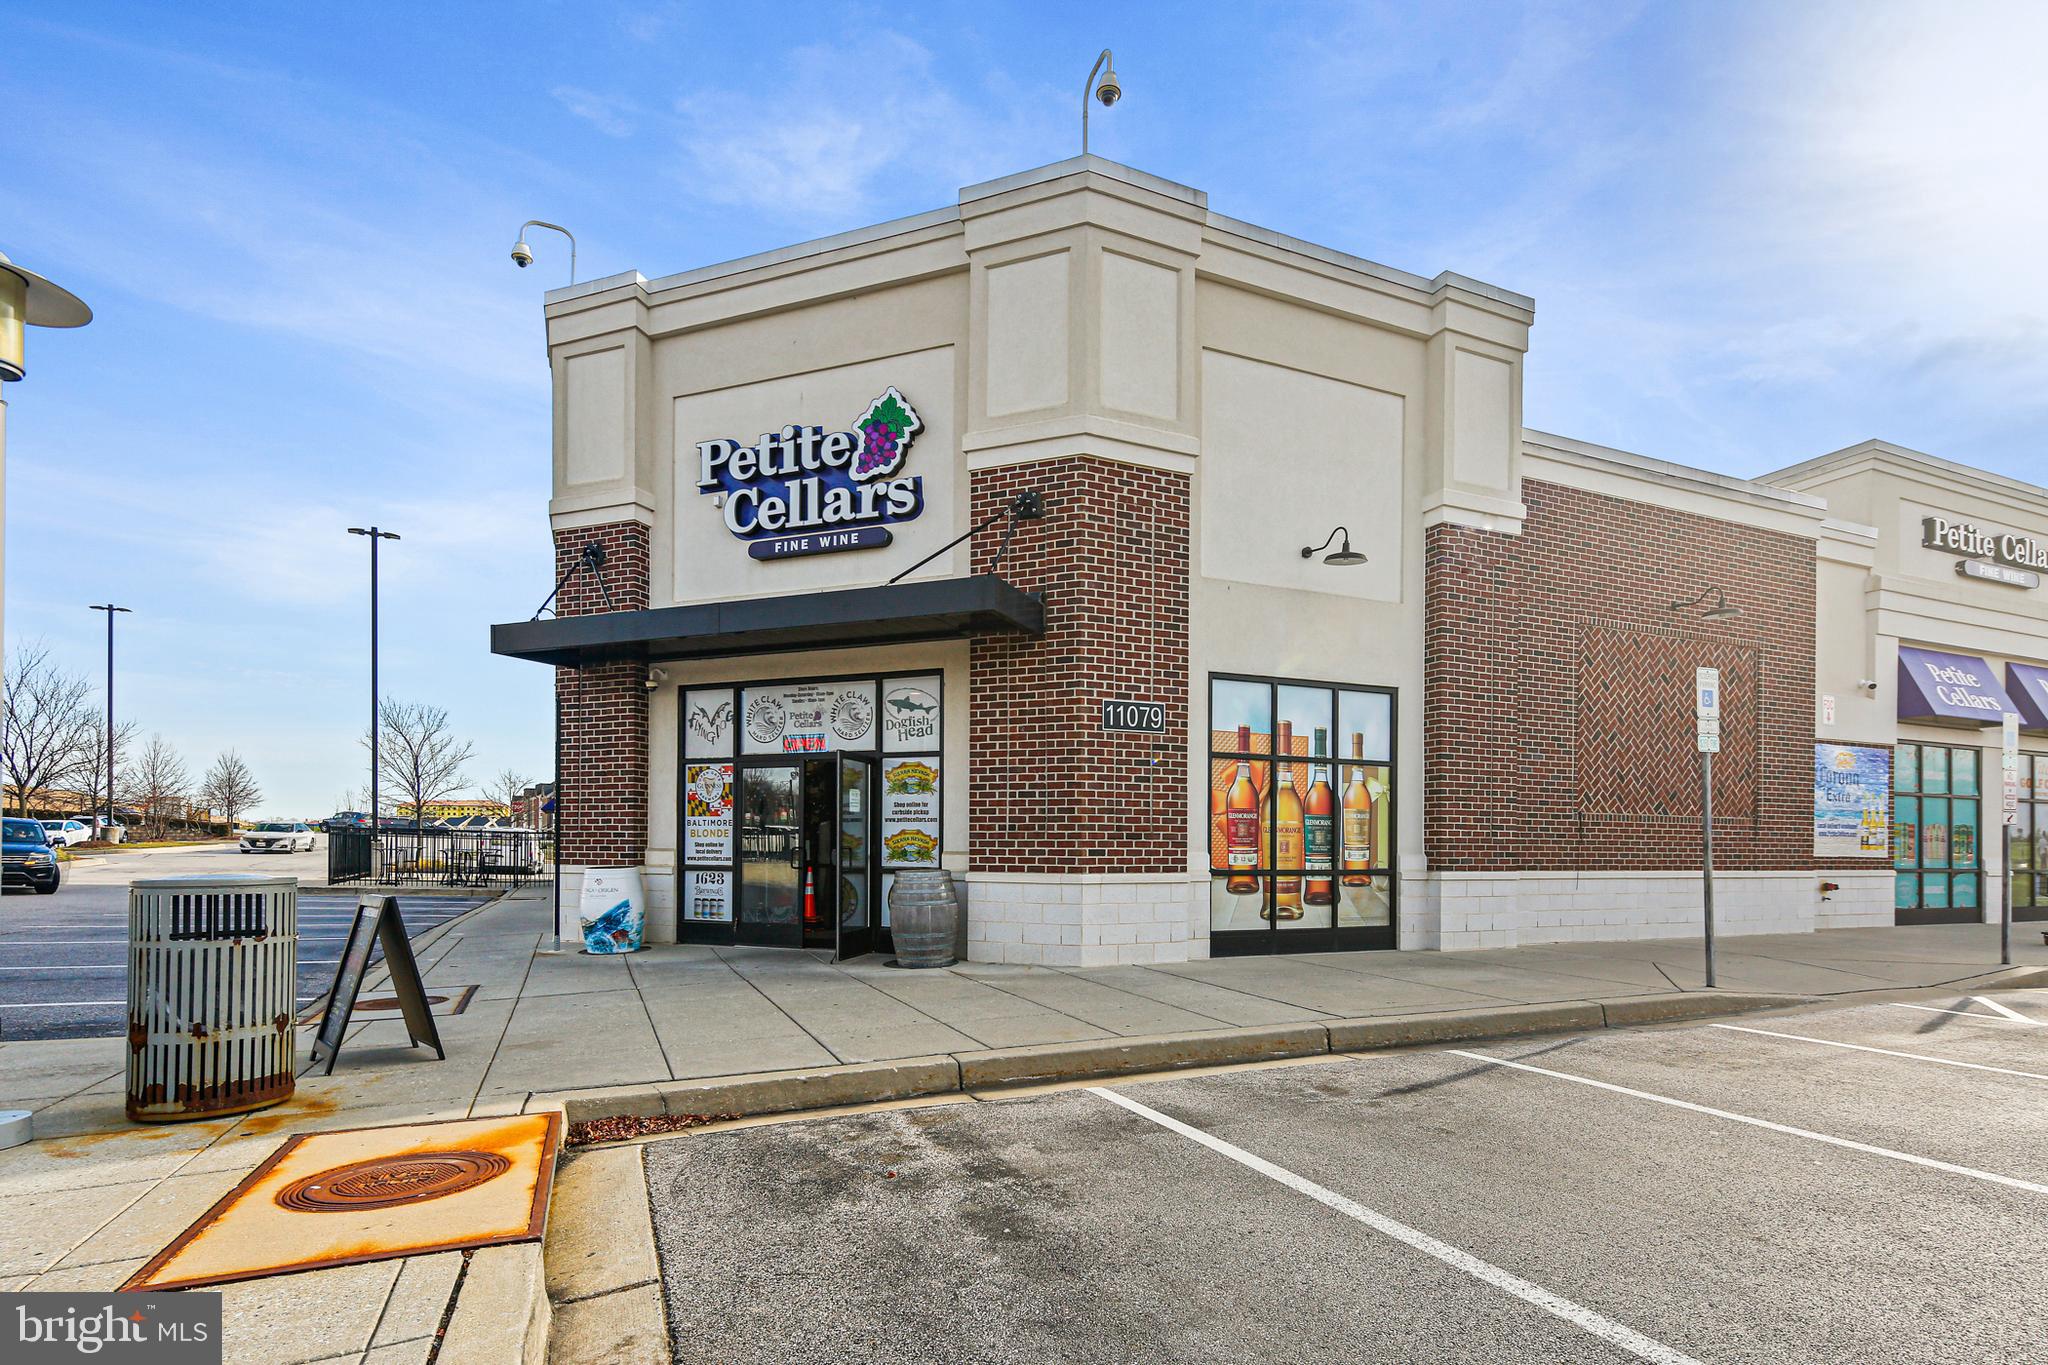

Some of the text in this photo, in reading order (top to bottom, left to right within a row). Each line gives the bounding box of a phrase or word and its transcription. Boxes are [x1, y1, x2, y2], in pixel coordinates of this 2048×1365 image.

[696, 425, 853, 487] Petite
[723, 476, 916, 534] Cellars
[775, 533, 859, 553] FINE WINE
[1933, 517, 2048, 568] Petite Cella
[1980, 565, 2025, 583] FINE WINE
[1925, 663, 1981, 688] Petite
[830, 691, 870, 723] WHITE CLAW
[1937, 686, 2002, 711] Cellars
[746, 695, 783, 727] WHITE CLAW
[790, 711, 814, 720] Petite
[1106, 704, 1162, 728] 11079
[794, 720, 823, 728] Cellars
[886, 716, 929, 730] Dogfish
[898, 723, 933, 741] Head
[783, 737, 827, 750] OPEN
[1820, 766, 1860, 786] Corona
[1826, 788, 1851, 802] Extra
[687, 819, 733, 827] BALTIMORE
[690, 829, 729, 838] BLONDE
[695, 872, 725, 885] 1623
